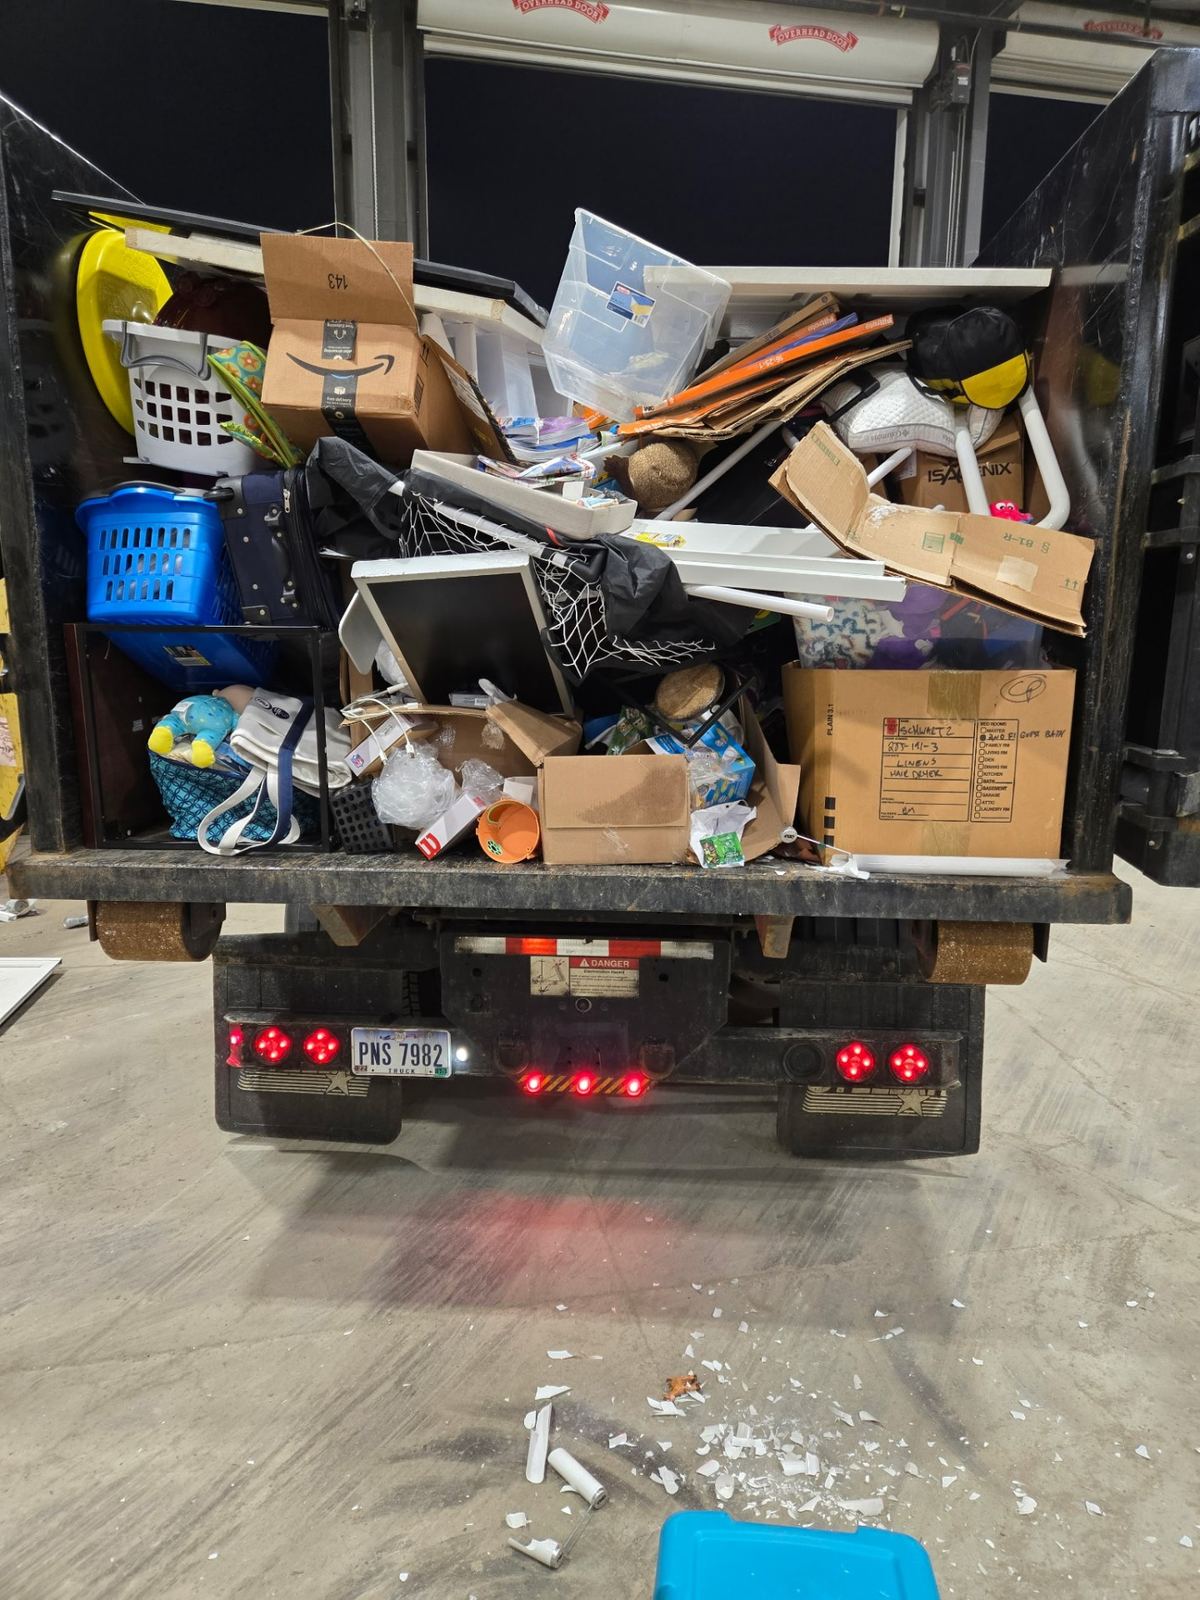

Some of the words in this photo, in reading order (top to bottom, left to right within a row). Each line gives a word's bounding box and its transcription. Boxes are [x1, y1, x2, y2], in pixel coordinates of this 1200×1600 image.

[574, 0, 599, 20] DOOR
[777, 28, 826, 42] OVERHEAD
[826, 32, 849, 50] DOOR
[328, 273, 348, 290] 143
[927, 462, 1012, 485] ISANIX
[591, 959, 630, 968] DANGER
[358, 1041, 392, 1066] PNS
[398, 1042, 443, 1067] 7982
